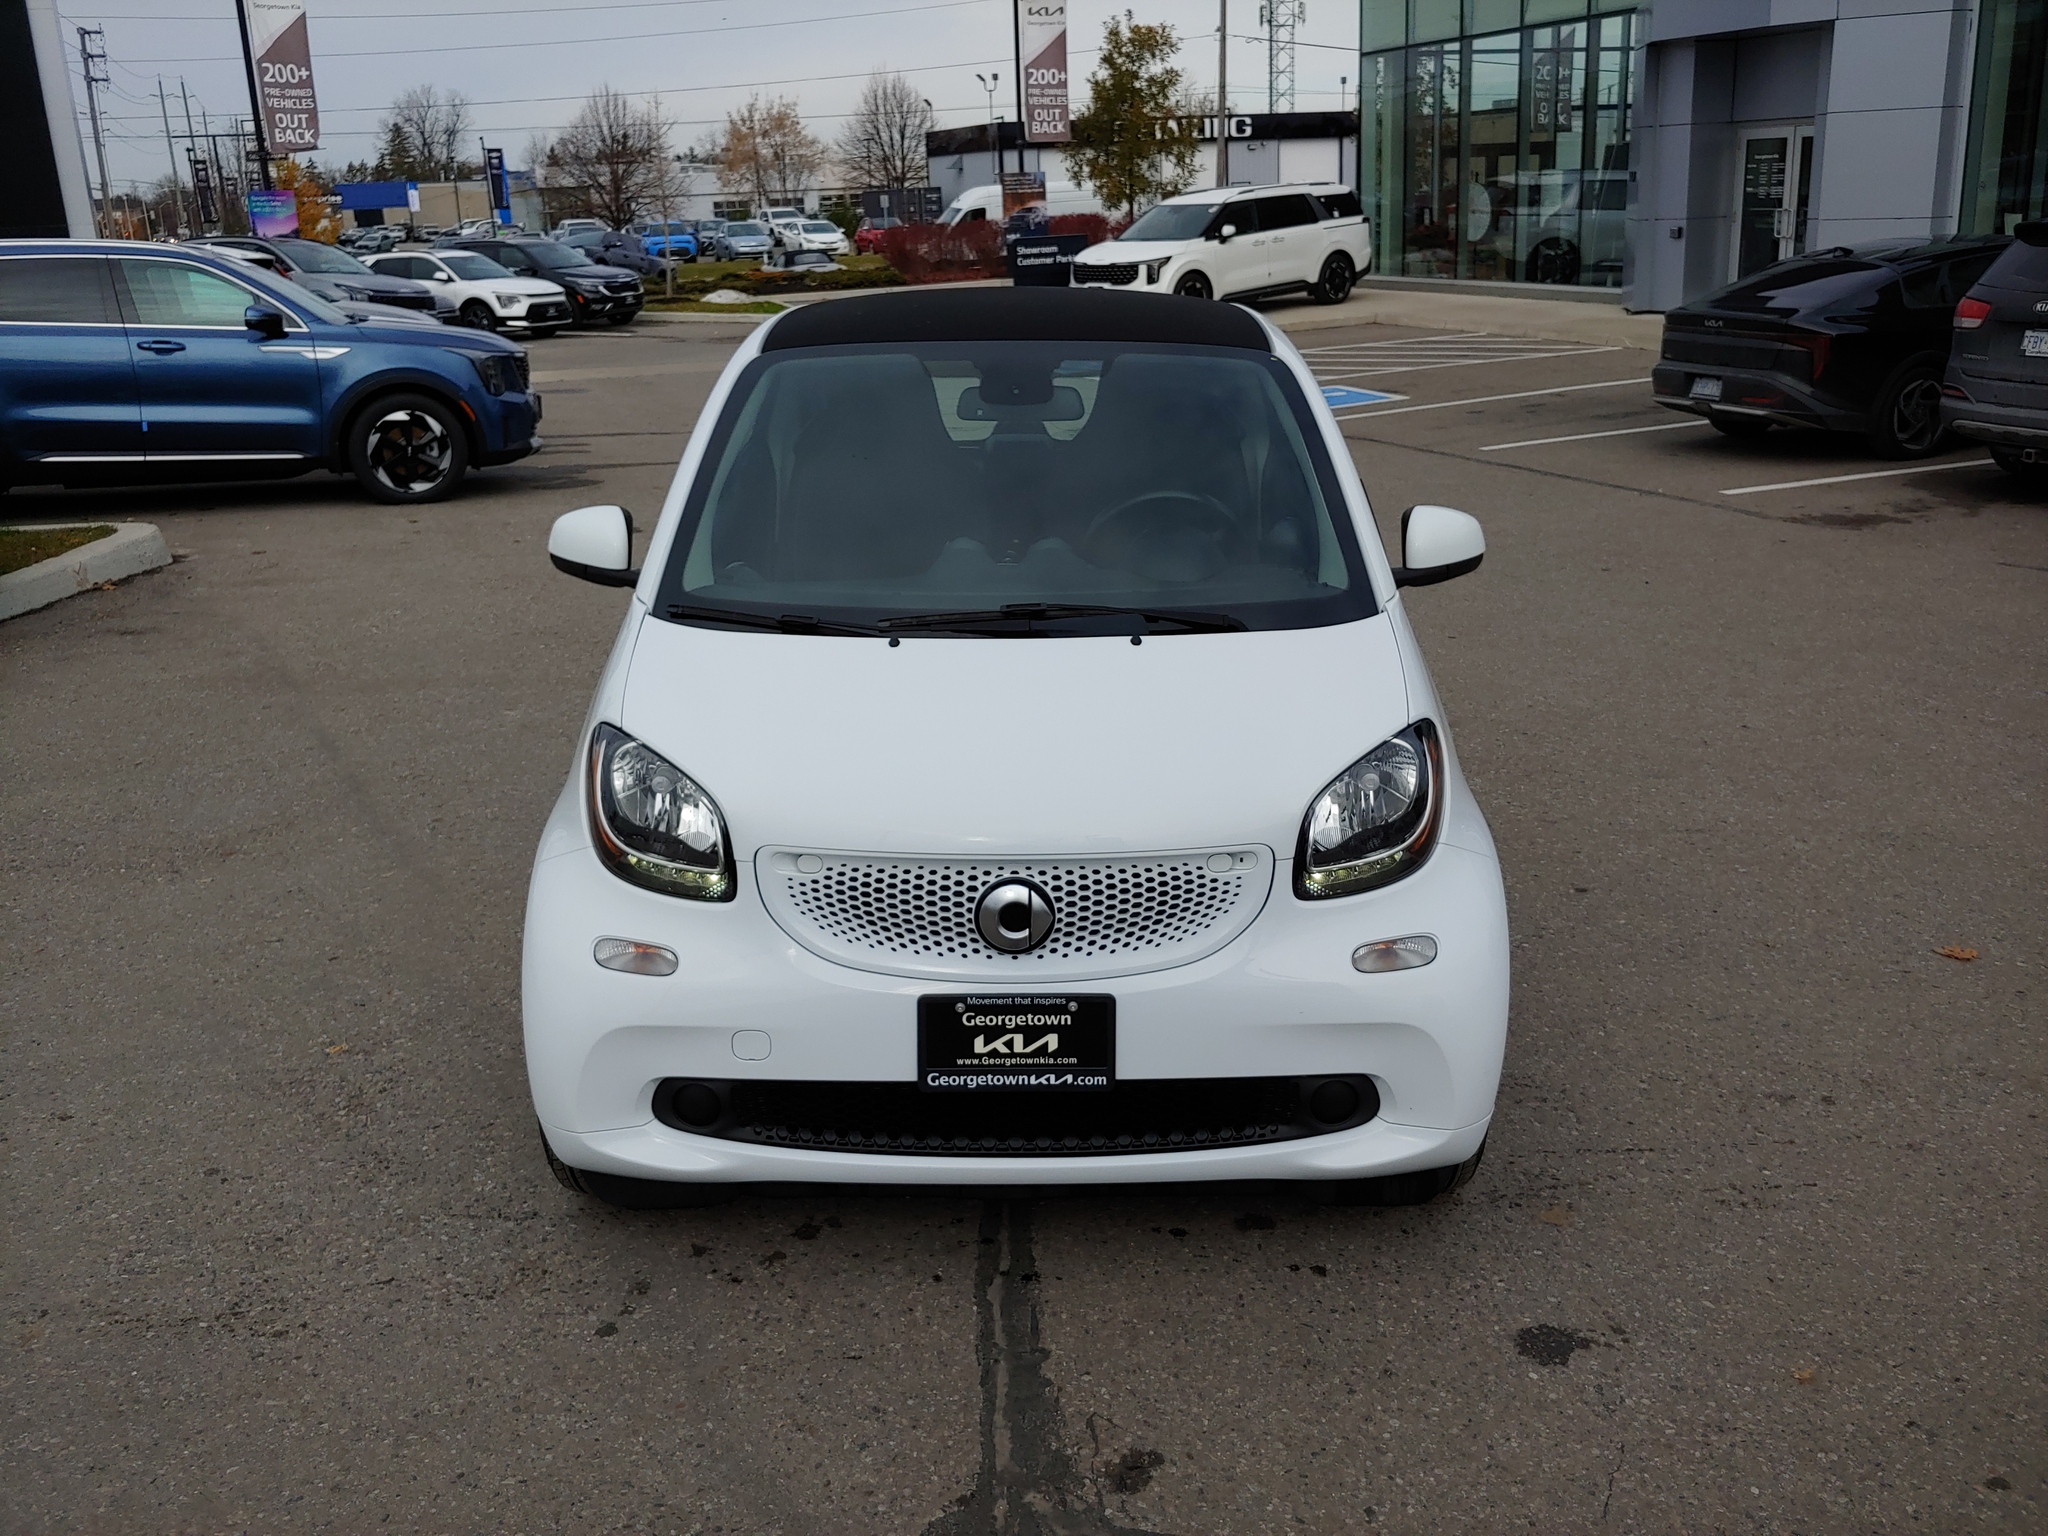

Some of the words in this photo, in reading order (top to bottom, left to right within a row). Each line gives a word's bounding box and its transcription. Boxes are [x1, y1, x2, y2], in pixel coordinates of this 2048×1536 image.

[1028, 6, 1064, 16] KIA
[261, 62, 310, 84] 200+
[1027, 68, 1067, 84] 200+
[264, 87, 313, 97] PRE-OWNED
[266, 97, 315, 109] VEHICLES
[1028, 96, 1067, 105] VEHICLES
[275, 112, 309, 129] OUT
[1033, 108, 1062, 121] OUT
[1031, 121, 1066, 133] BACK
[274, 127, 316, 144] BACK
[1016, 246, 1059, 255] Showroom
[1016, 257, 1055, 266] Customer
[1704, 319, 1723, 327] KIA
[967, 996, 1012, 1005] Movement
[1014, 996, 1031, 1005] that
[1033, 996, 1067, 1006] inspires
[961, 1012, 1072, 1029] Georgetown
[973, 1033, 1059, 1054] KIA
[956, 1056, 1078, 1067] www.Georgetownkia.com
